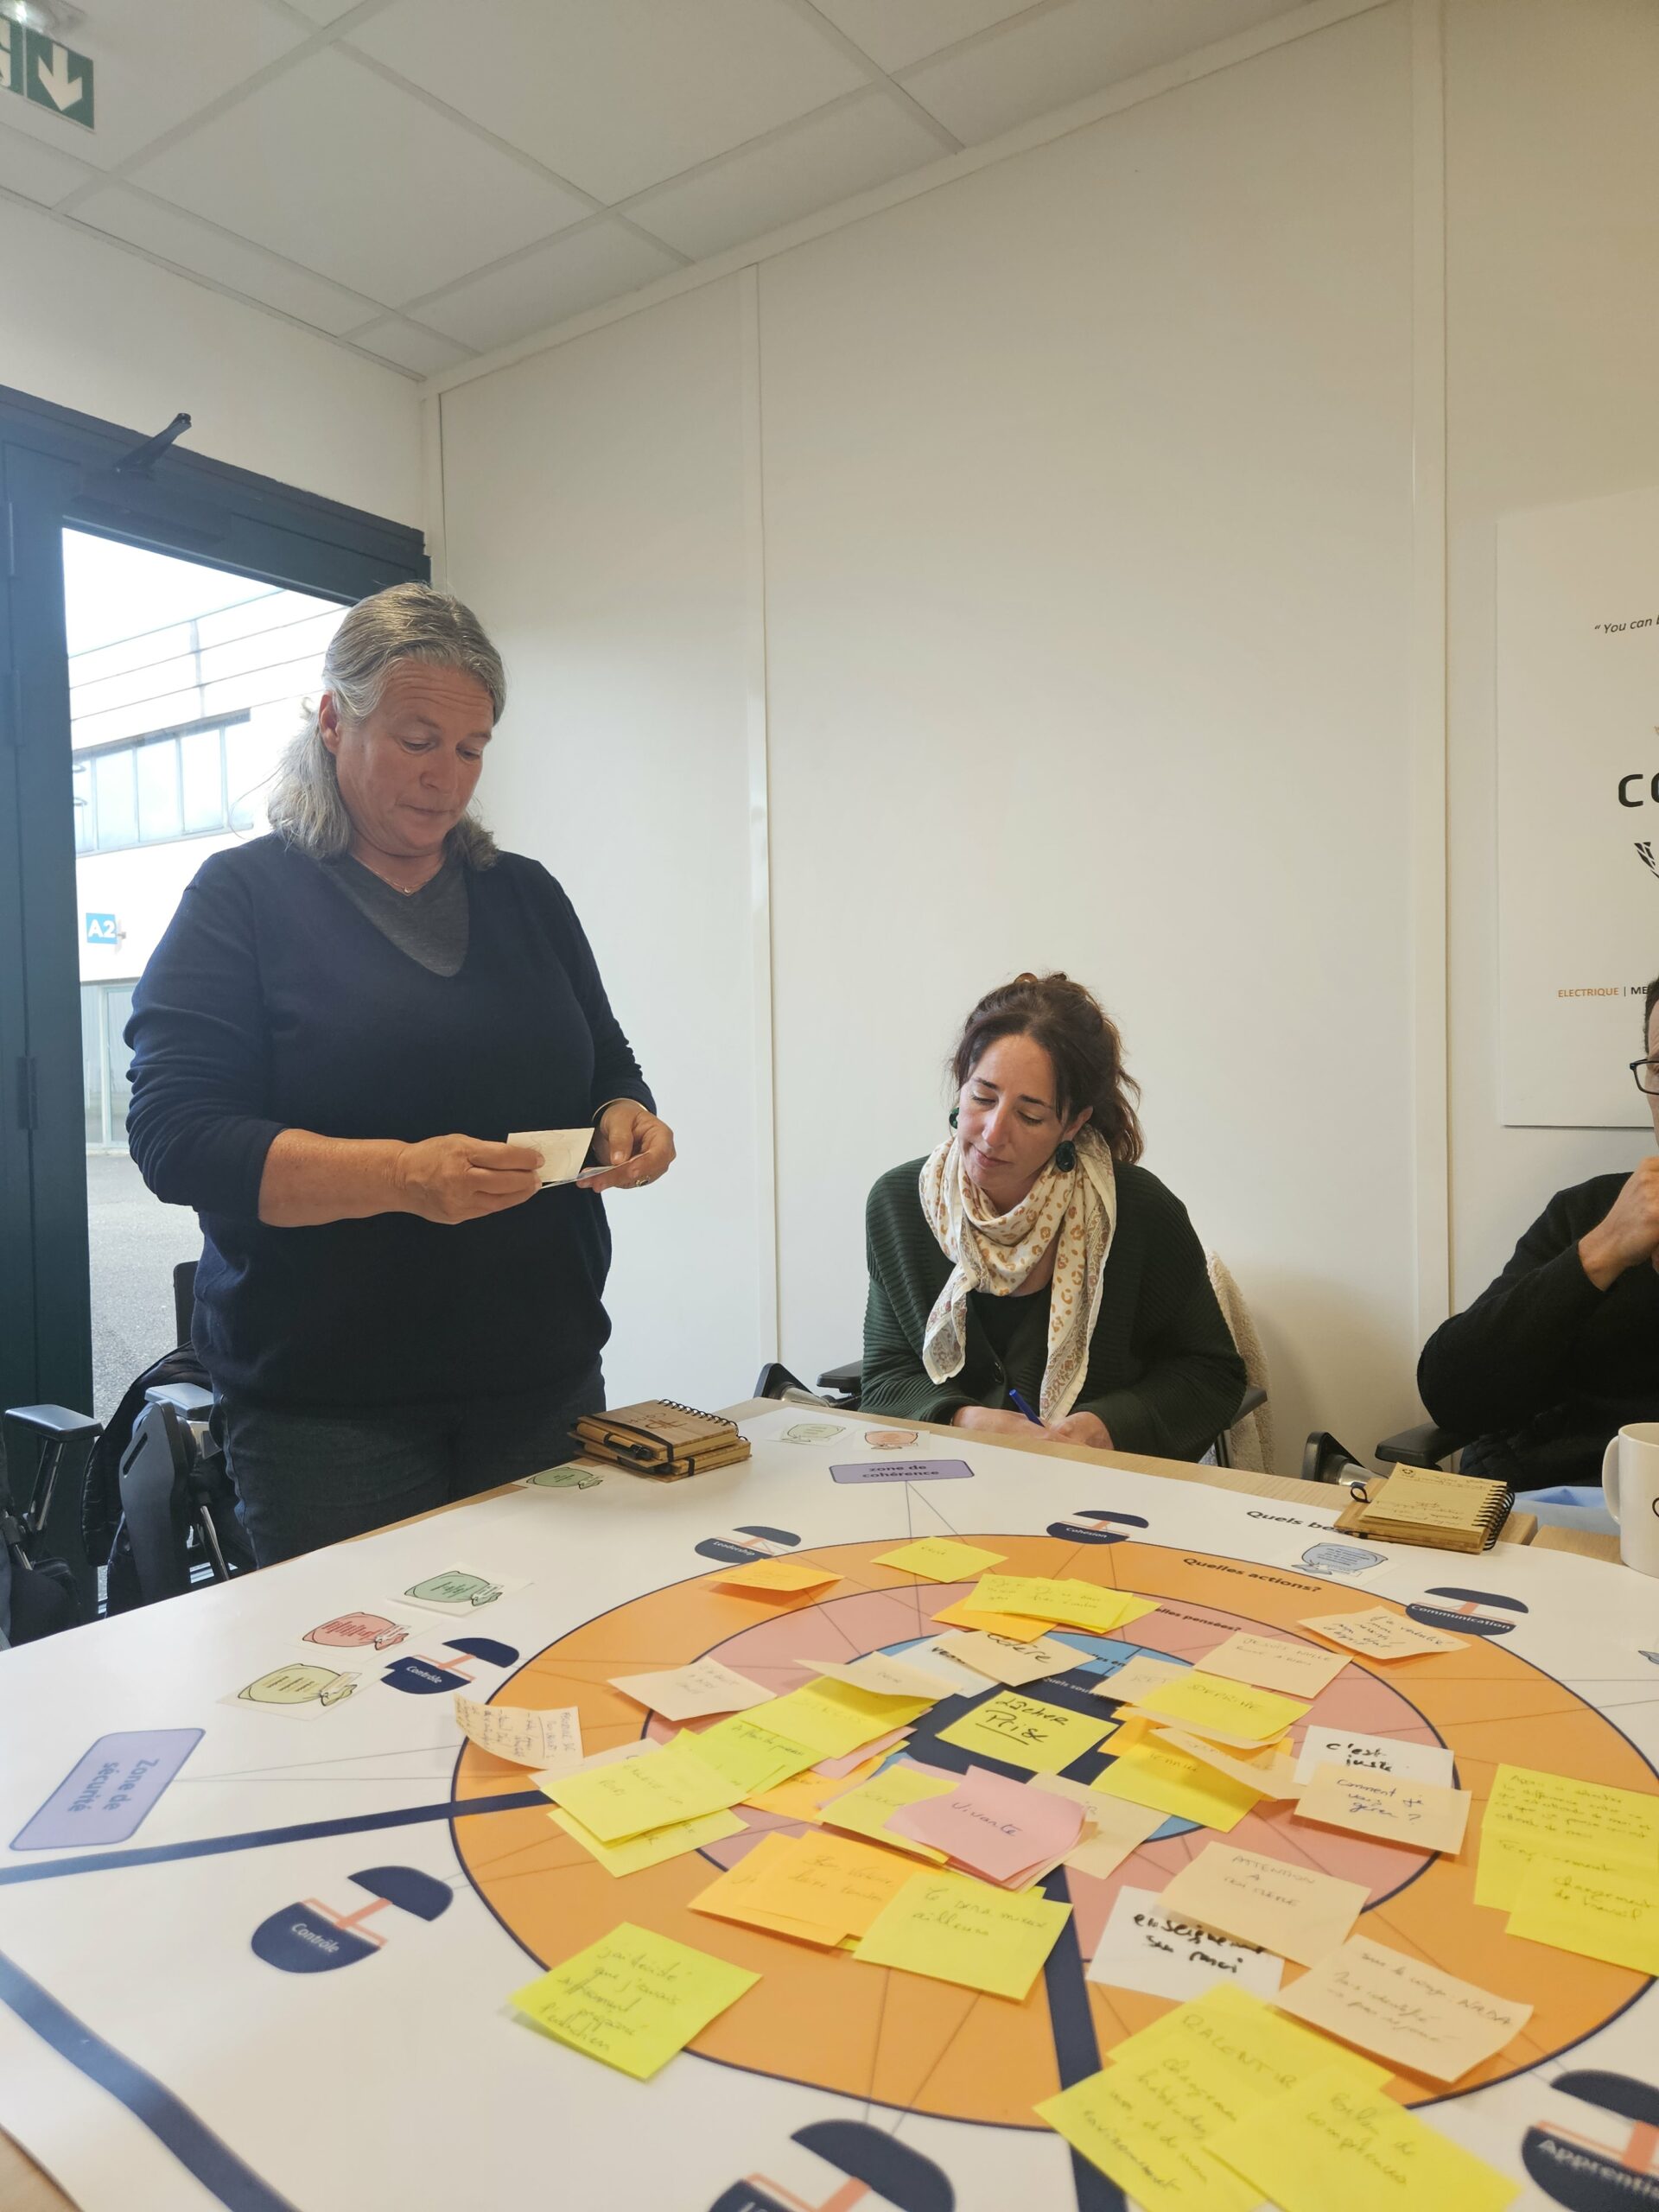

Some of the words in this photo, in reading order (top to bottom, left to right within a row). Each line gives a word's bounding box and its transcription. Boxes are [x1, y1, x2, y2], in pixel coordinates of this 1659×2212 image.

[1604, 621, 1626, 633] You
[1630, 619, 1652, 629] can
[87, 918, 117, 938] A2
[1558, 988, 1619, 997] ELECTRIQUE
[1246, 1510, 1303, 1524] Quels
[713, 1541, 756, 1555] Leadership
[1183, 1558, 1244, 1575] Quelles
[1248, 1573, 1322, 1592] actions?
[1154, 1607, 1181, 1618] elles
[1411, 1605, 1510, 1630] Communication
[405, 1665, 443, 1684] Contrôle
[118, 1758, 160, 1791] Zone
[67, 1762, 120, 1812] sécurité
[103, 1793, 131, 1811] de
[291, 1923, 340, 1954] Contrôle
